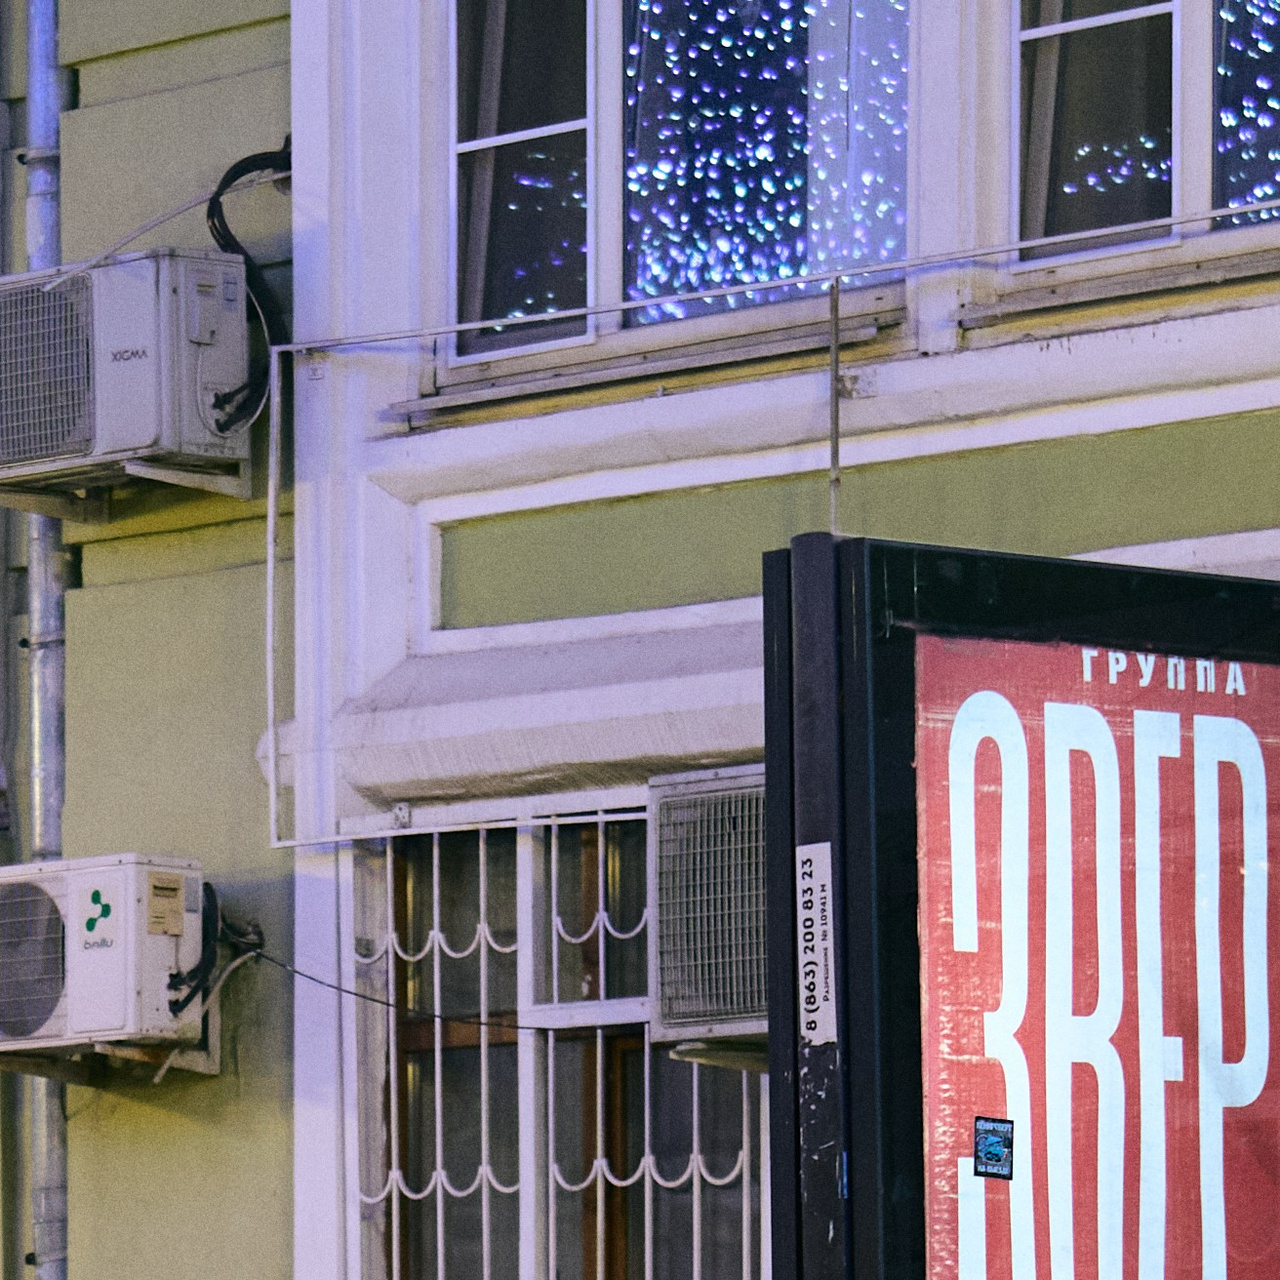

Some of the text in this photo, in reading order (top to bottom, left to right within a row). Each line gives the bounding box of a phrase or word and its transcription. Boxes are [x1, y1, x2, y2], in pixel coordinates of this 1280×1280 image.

[1082, 647, 1246, 695] ГРУППА
[801, 858, 820, 1031] 8 (863) 200 83 23
